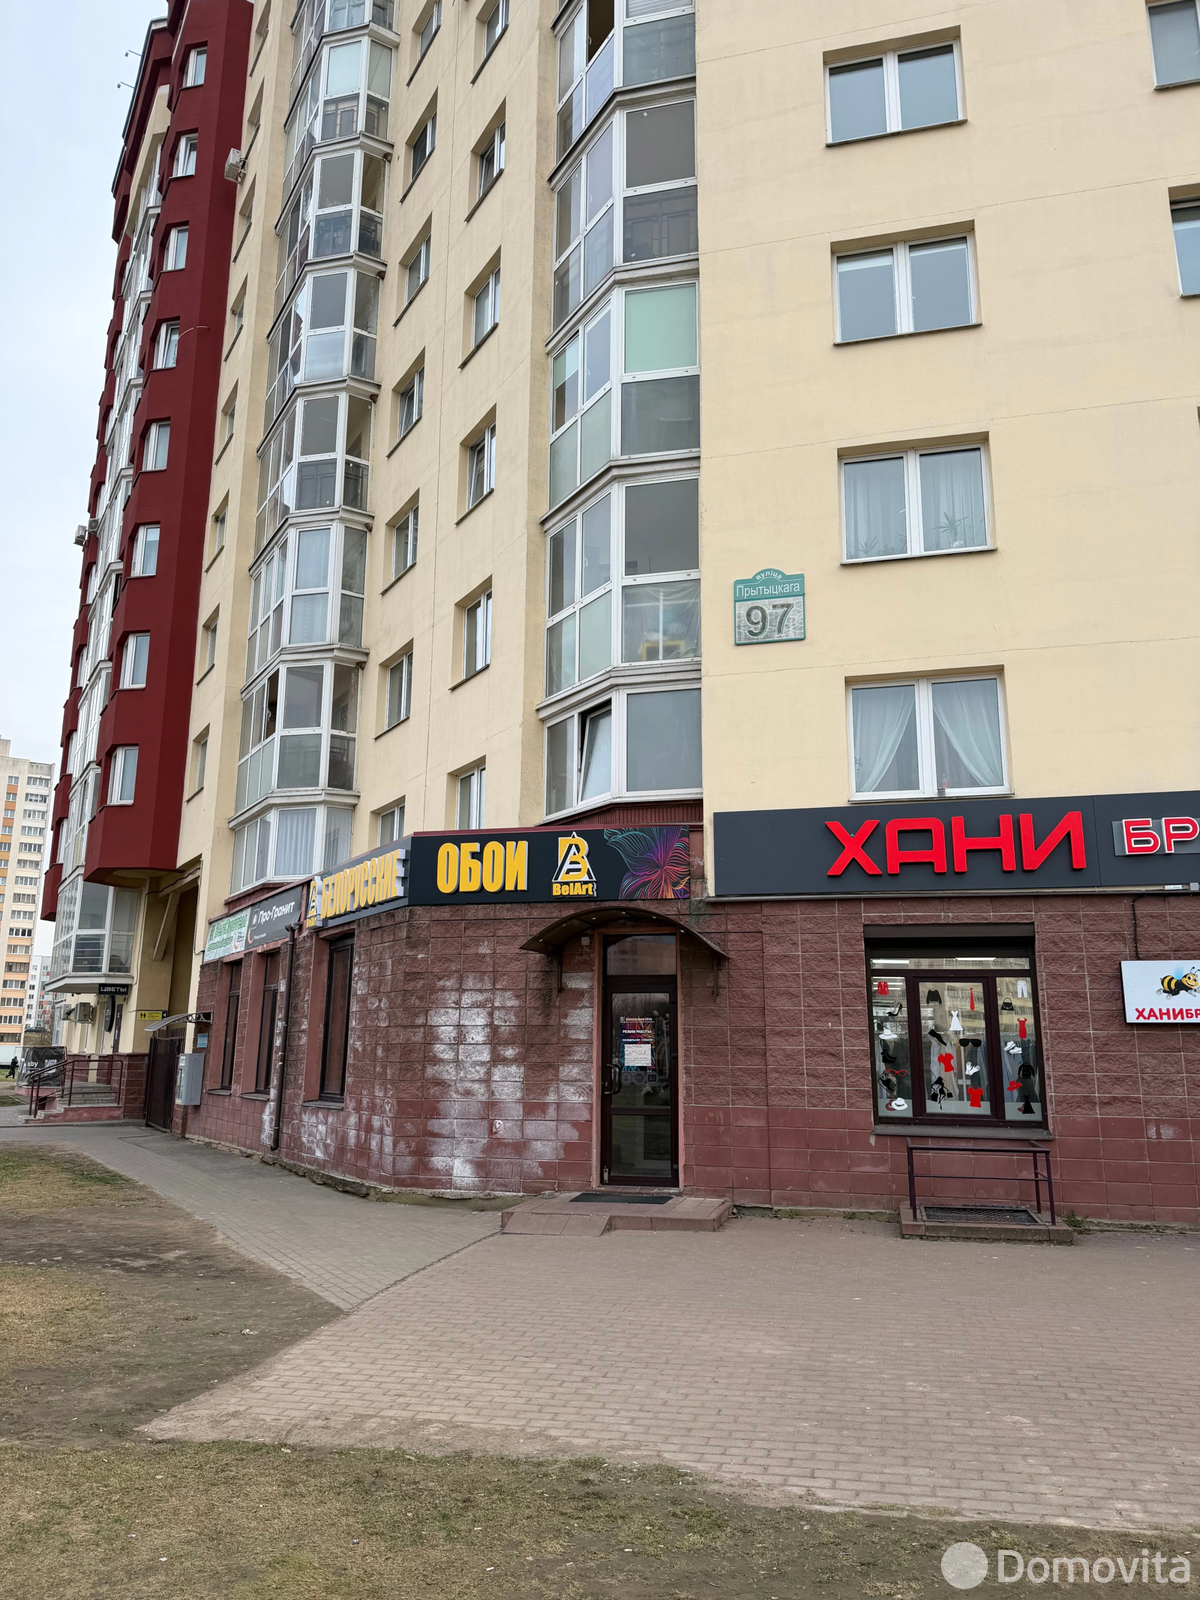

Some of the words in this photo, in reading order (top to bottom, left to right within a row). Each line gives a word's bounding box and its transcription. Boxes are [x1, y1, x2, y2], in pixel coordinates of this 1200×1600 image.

[756, 570, 783, 581] вуліца
[736, 583, 800, 599] Прытыцкага
[746, 603, 794, 637] 97
[825, 811, 1087, 876] ХАНИ
[1122, 816, 1200, 855] БР
[320, 849, 403, 919] БЕЛОРУССКИЕ
[436, 840, 528, 894] ОБОИ
[552, 882, 595, 896] BelArt
[258, 902, 296, 925] Про-Гранит
